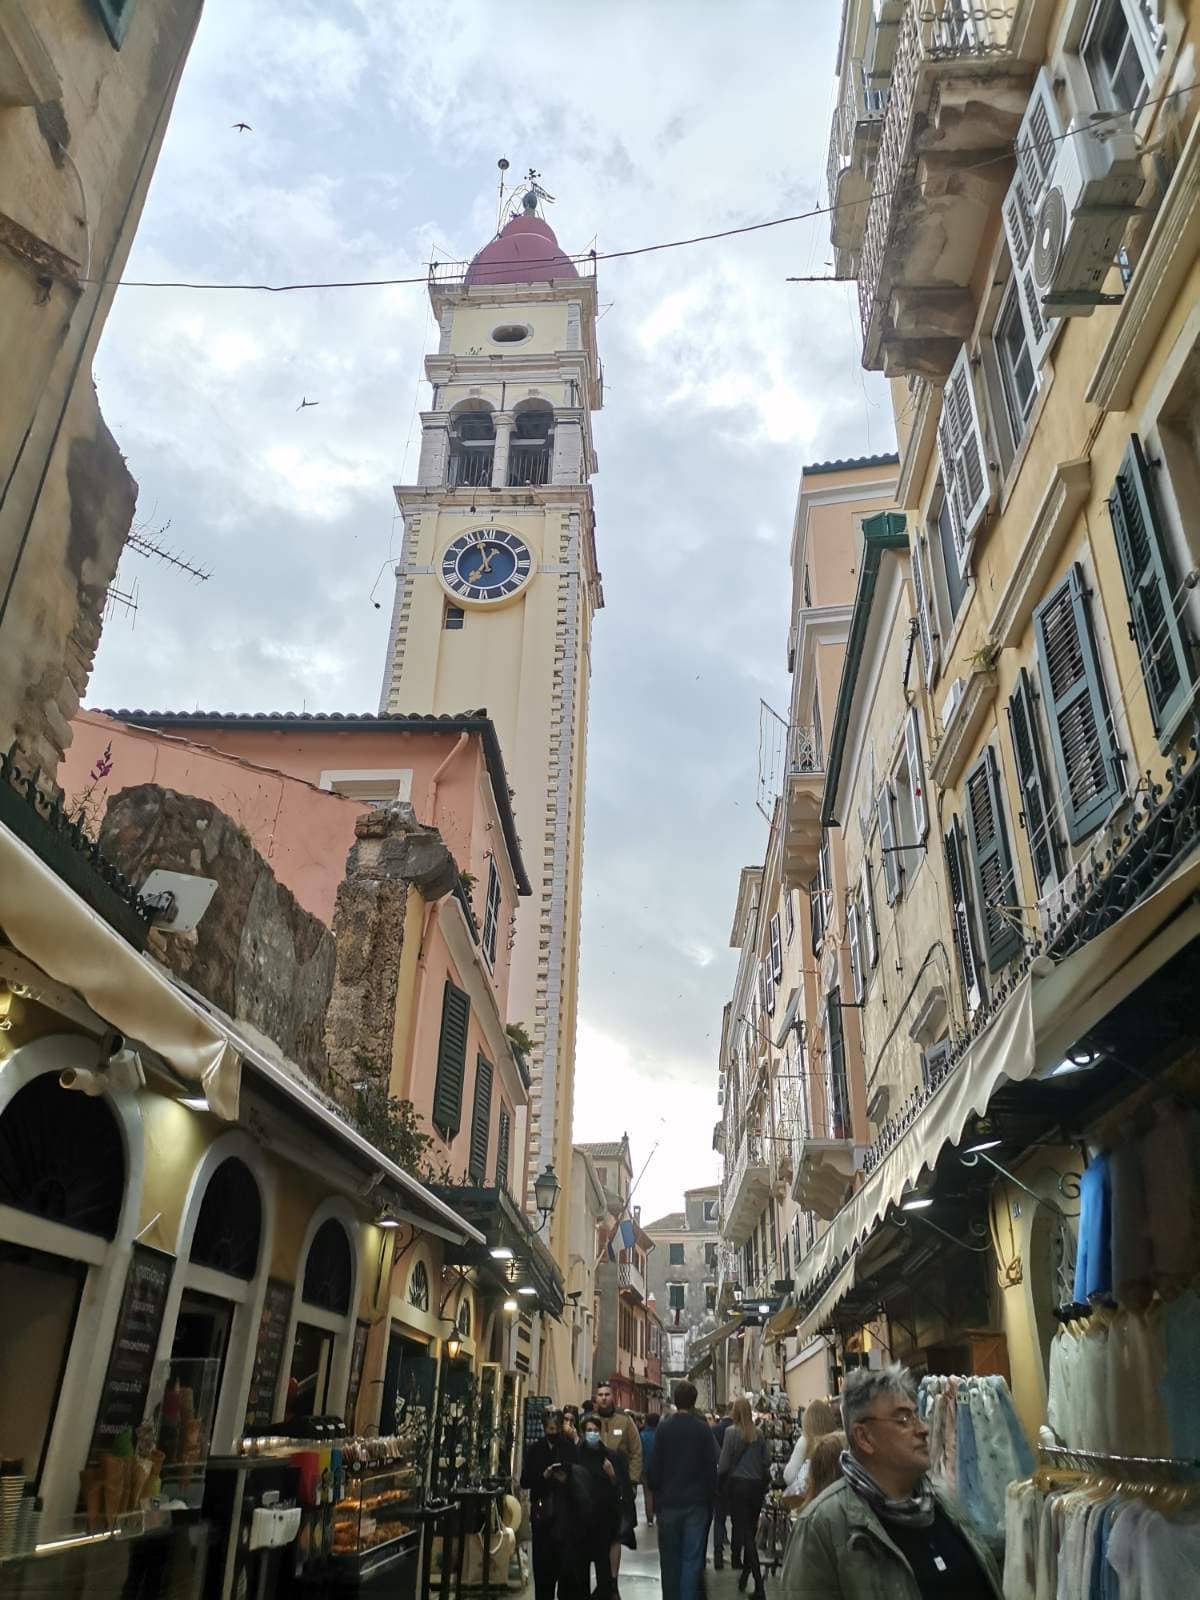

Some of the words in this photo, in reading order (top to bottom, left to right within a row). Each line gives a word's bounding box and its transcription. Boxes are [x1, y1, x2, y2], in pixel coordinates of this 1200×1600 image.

[483, 529, 496, 539] XII
[504, 533, 512, 543] I
[515, 545, 527, 553] II
[518, 560, 530, 568] III
[479, 589, 488, 599] VI
[500, 586, 509, 596] V
